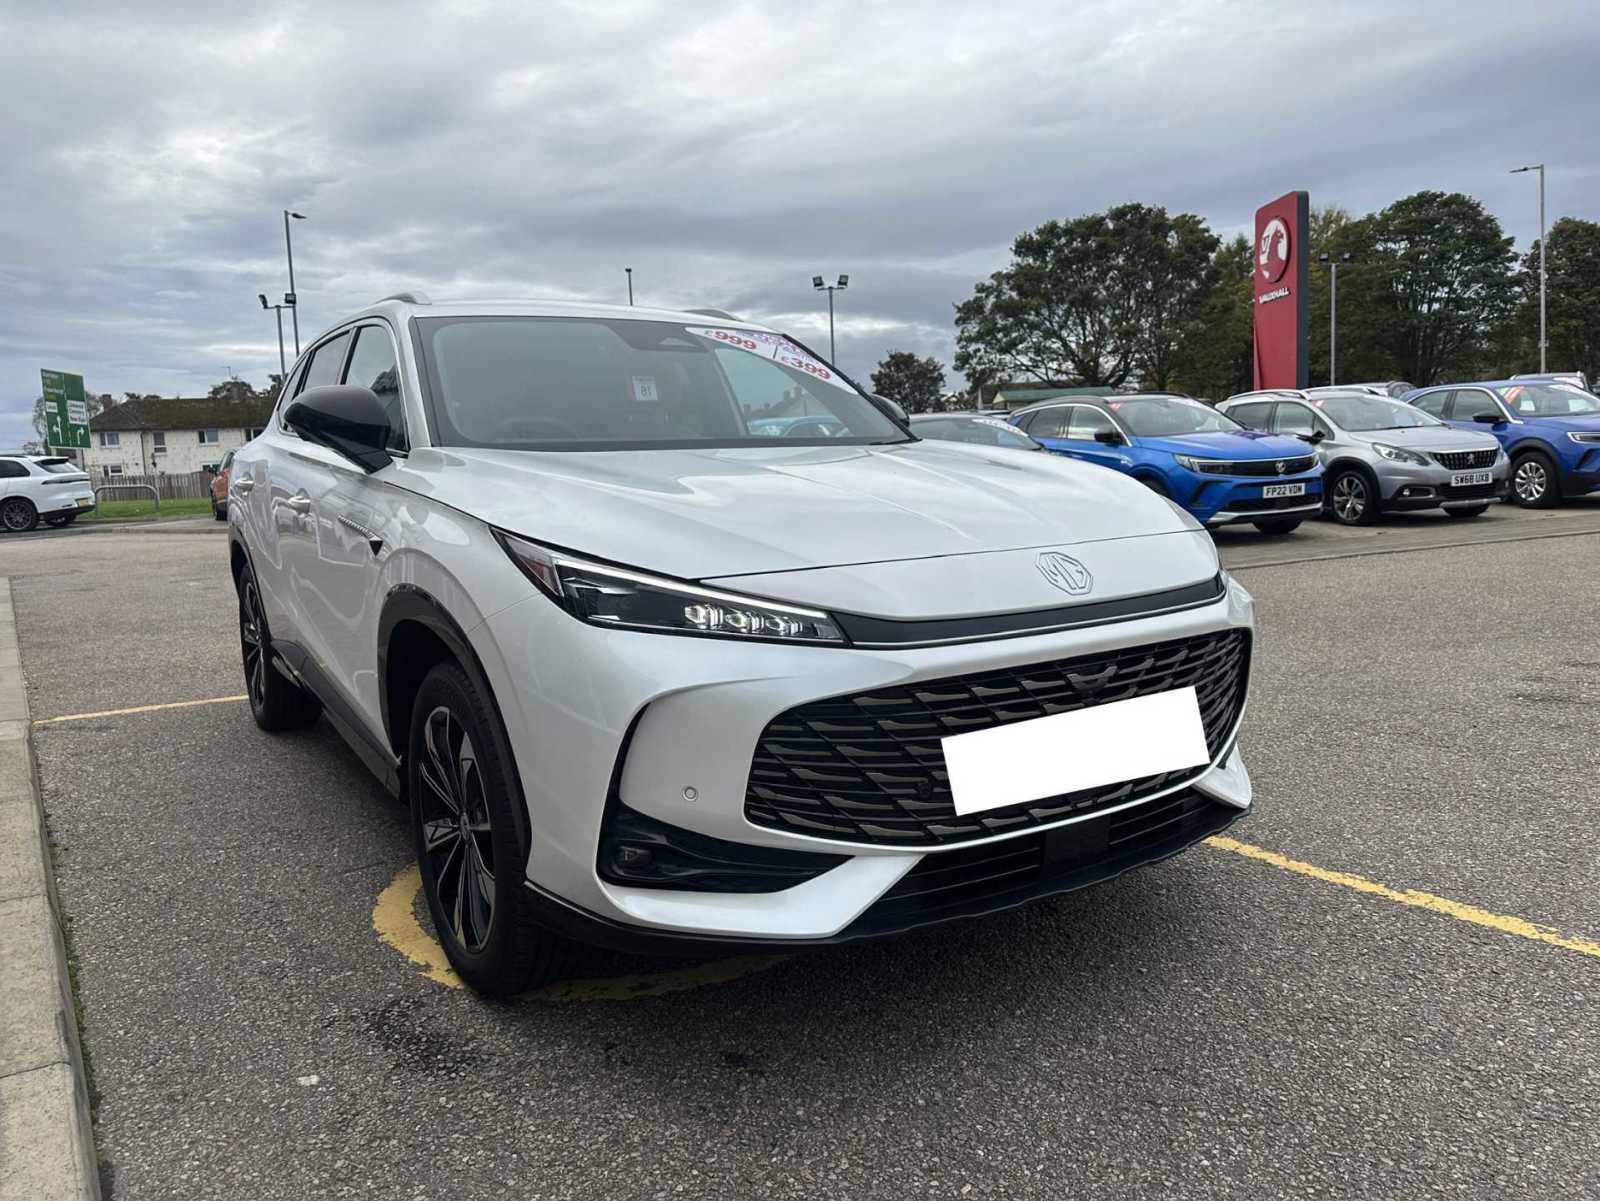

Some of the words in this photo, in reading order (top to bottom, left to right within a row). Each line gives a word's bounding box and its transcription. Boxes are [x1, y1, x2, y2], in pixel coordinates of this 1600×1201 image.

[704, 330, 757, 350] £999
[781, 356, 831, 380] £399
[1265, 486, 1287, 497] FP22
[1037, 553, 1091, 594] MG
